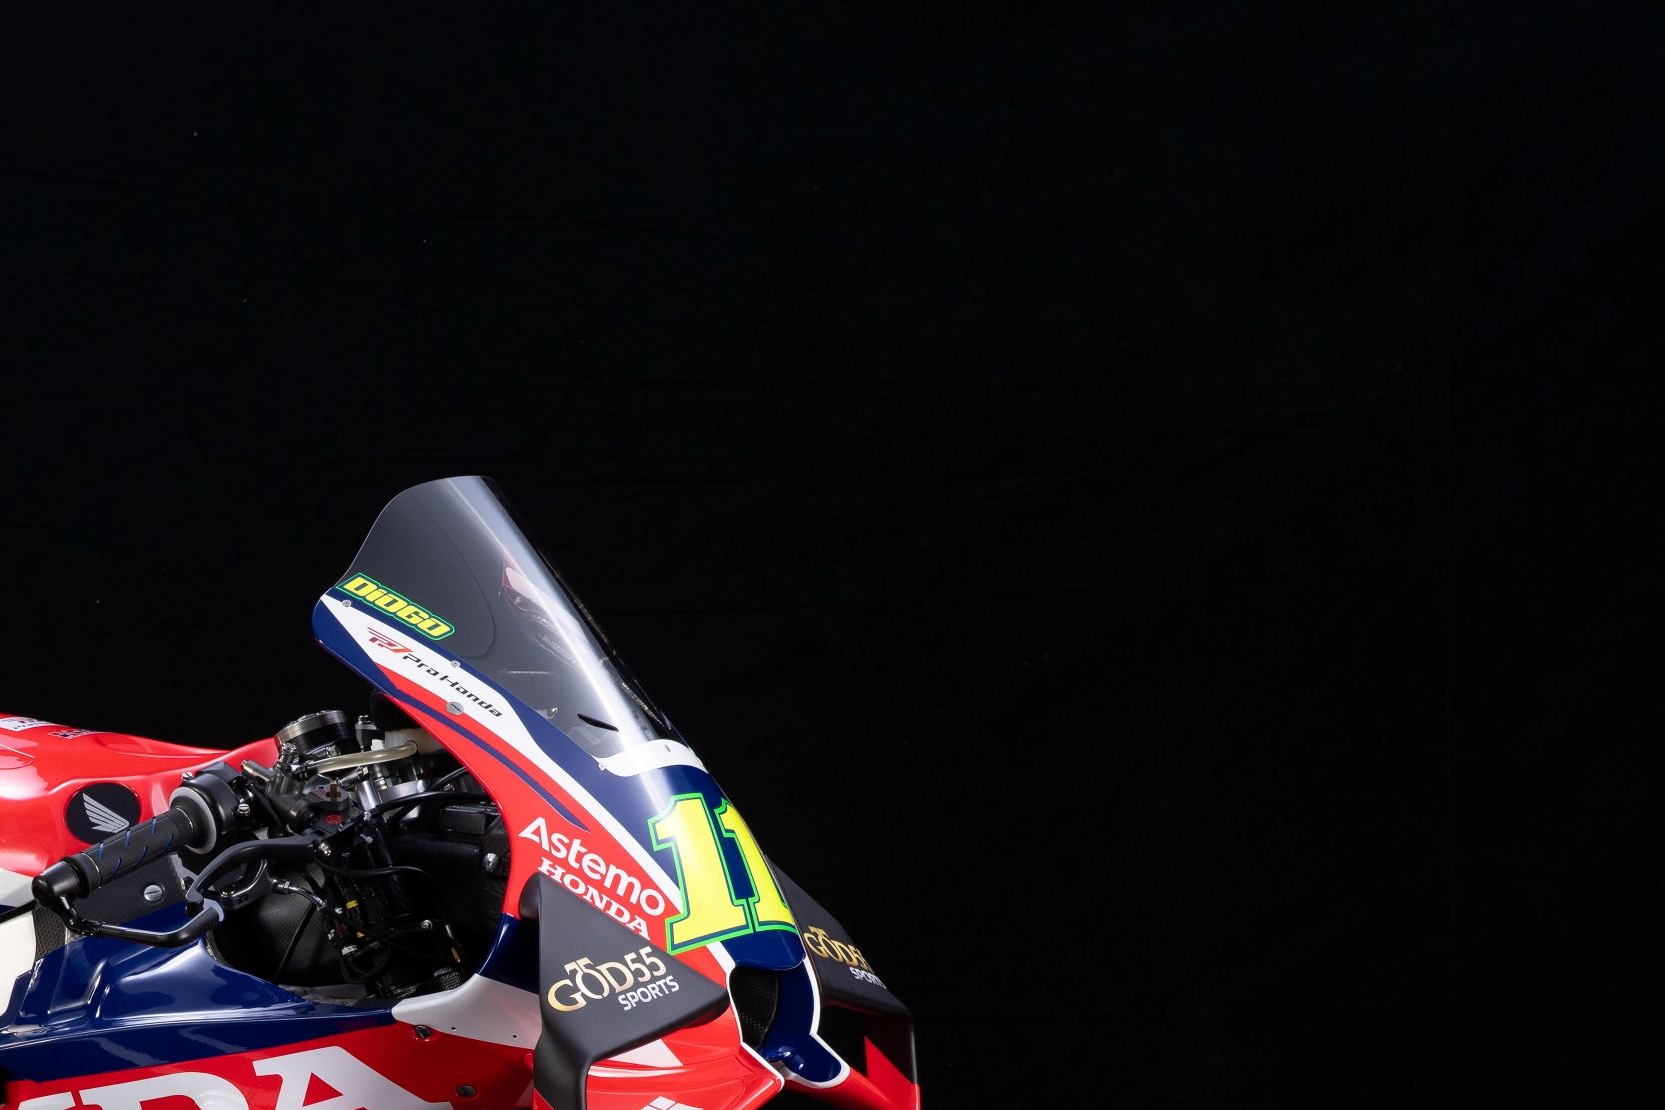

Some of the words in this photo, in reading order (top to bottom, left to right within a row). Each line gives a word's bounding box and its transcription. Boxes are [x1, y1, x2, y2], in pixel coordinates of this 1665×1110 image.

[402, 653, 439, 676] Pro
[440, 675, 503, 718] Honda
[518, 816, 666, 916] Astemo
[537, 856, 651, 941] HONDA
[647, 792, 796, 952] 11
[618, 975, 680, 1011] SPORTS
